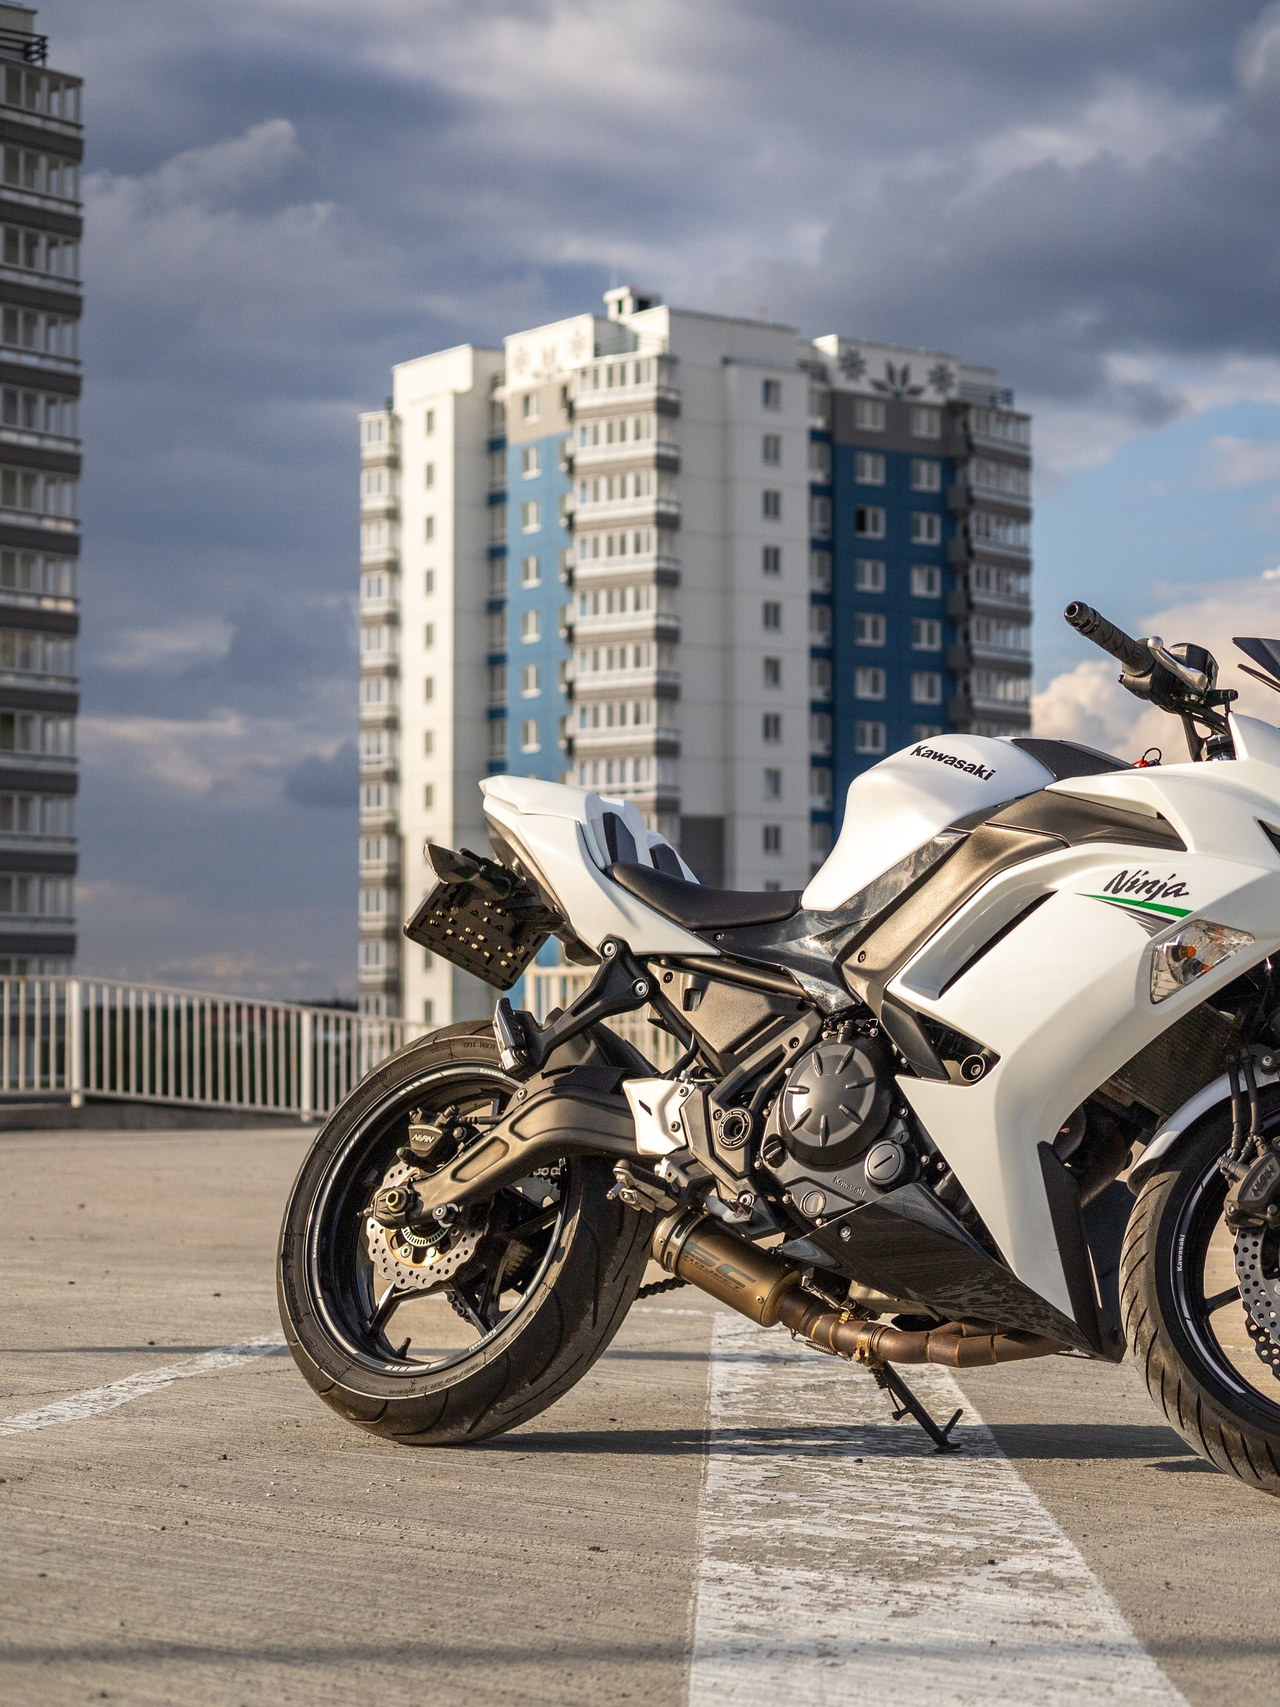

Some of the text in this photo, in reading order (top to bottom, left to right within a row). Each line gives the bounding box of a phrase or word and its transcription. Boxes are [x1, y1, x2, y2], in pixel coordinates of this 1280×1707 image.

[910, 744, 997, 781] Kawasaki
[1103, 869, 1190, 906] Ninja
[833, 1175, 867, 1197] Kawasaki
[1177, 1234, 1186, 1272] Kawasaki
[469, 1328, 498, 1353] Kawasaki
